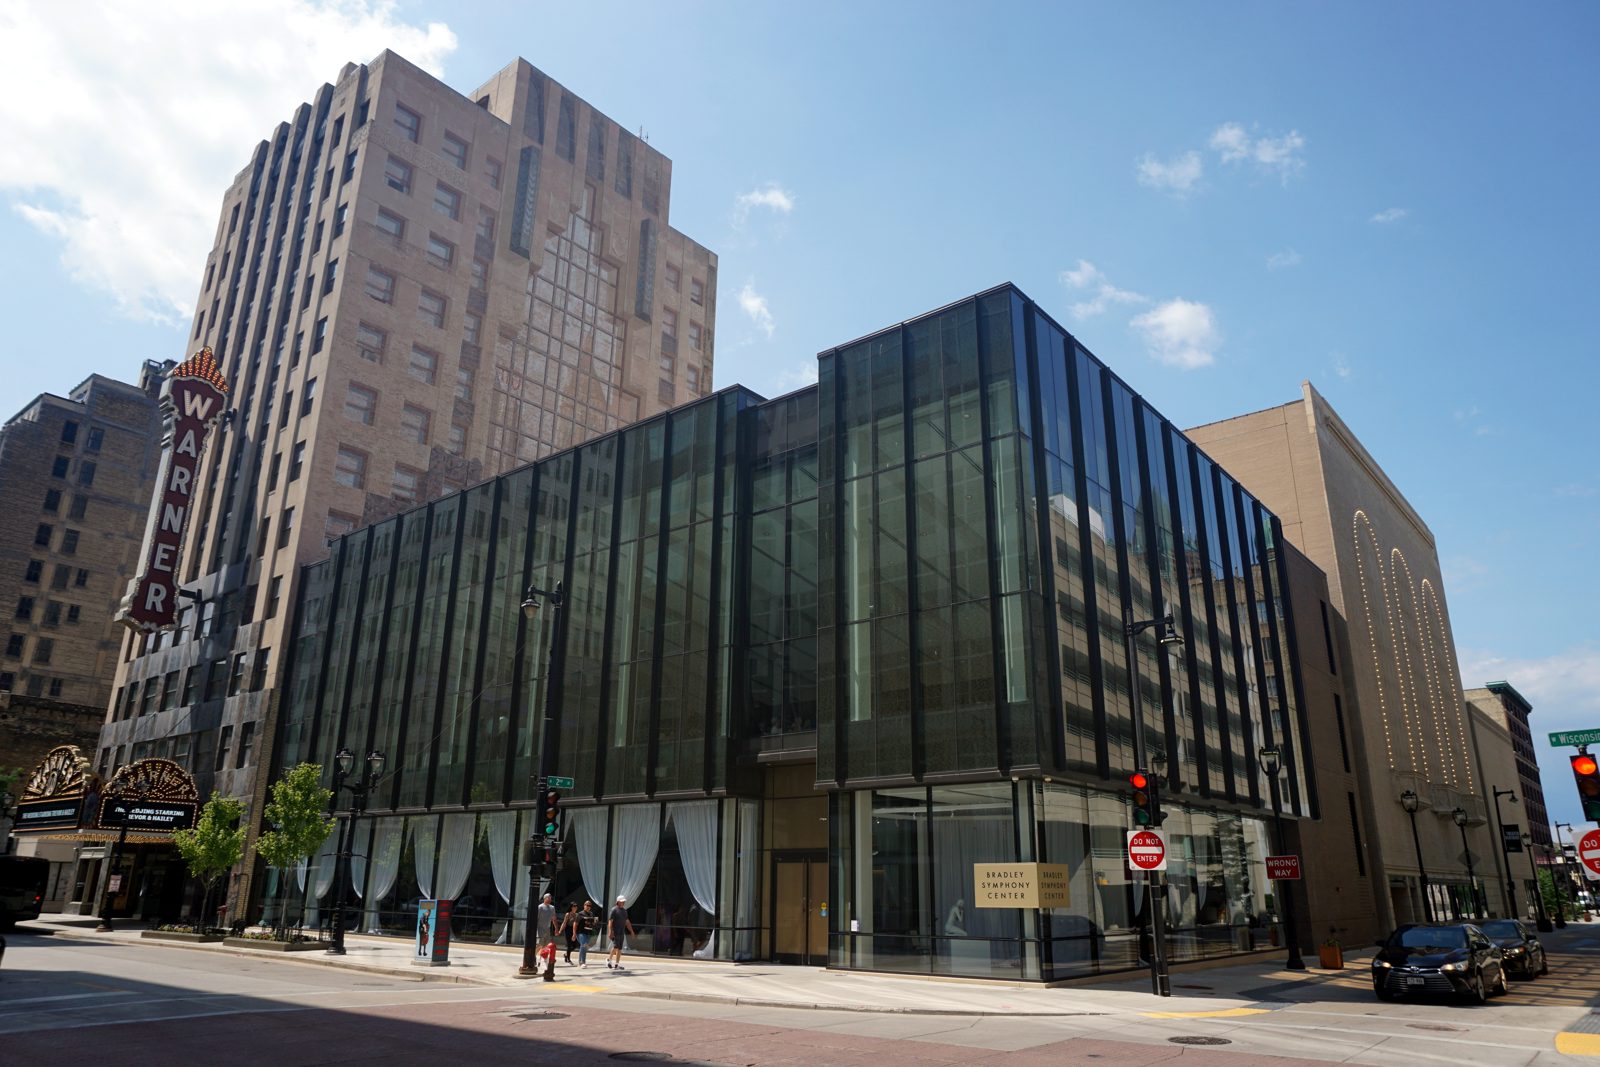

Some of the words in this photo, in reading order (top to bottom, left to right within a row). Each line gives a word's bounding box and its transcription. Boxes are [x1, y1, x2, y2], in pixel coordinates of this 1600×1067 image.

[145, 389, 212, 613] WARNER
[1583, 839, 1598, 848] DO
[1267, 859, 1297, 867] WRONG
[986, 871, 1024, 879] BRADLEY
[1043, 871, 1063, 879] BRADLEY
[1274, 869, 1291, 877] WAY
